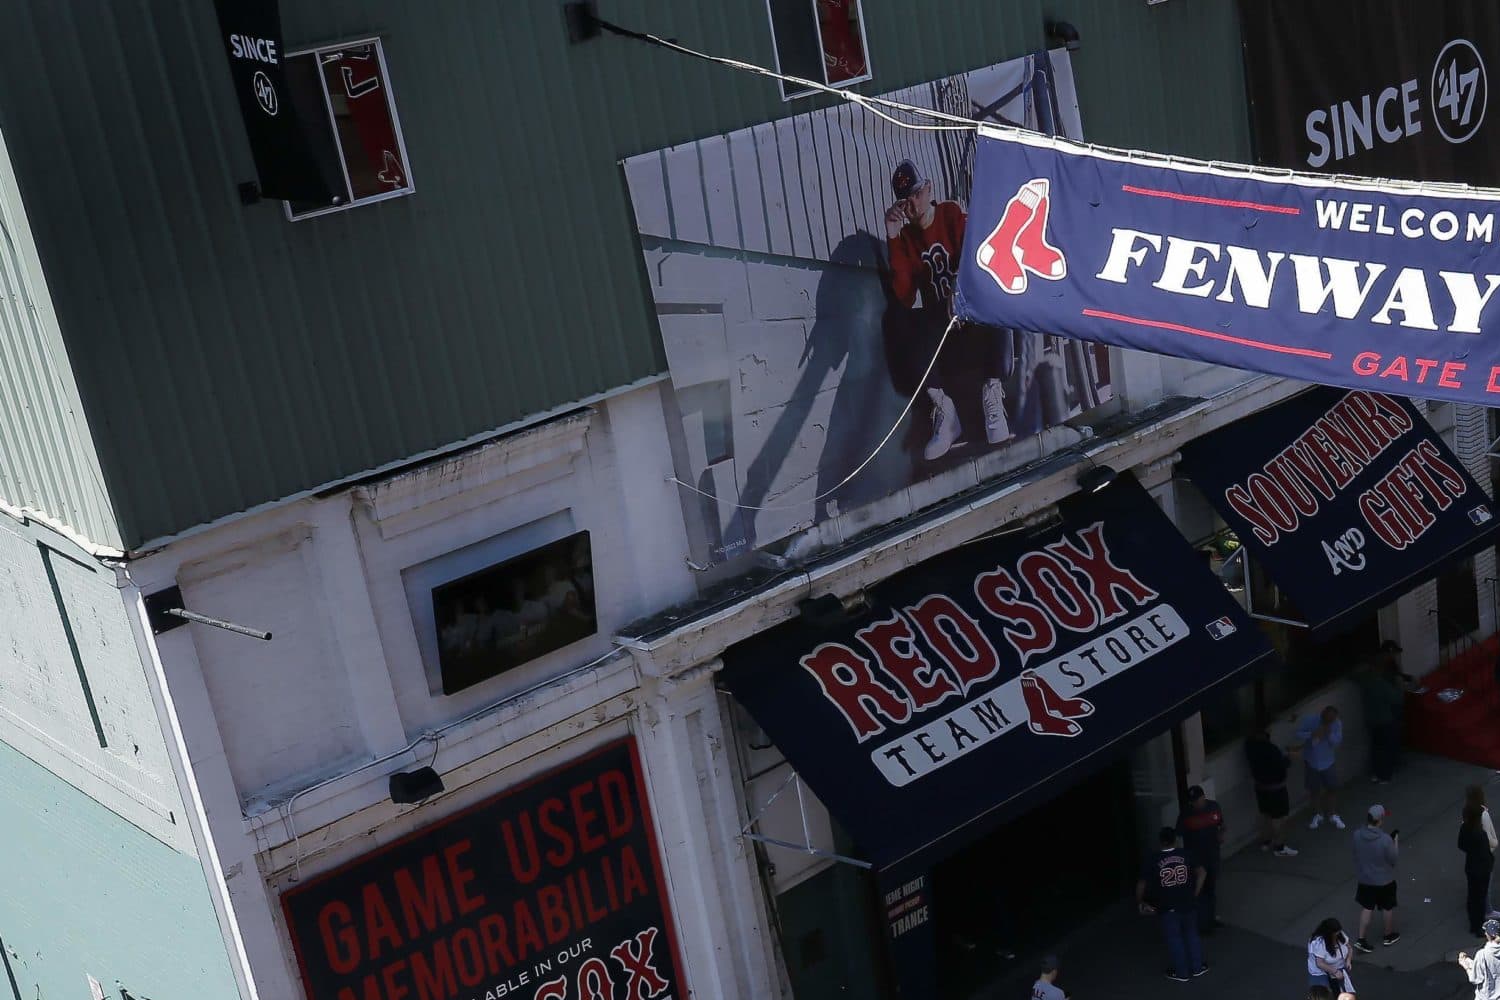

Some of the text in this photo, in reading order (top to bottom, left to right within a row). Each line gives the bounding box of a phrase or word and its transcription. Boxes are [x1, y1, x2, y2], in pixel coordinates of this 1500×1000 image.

[230, 34, 278, 64] SINCE
[1305, 78, 1422, 167] SINCE
[1352, 351, 1466, 389] GATE
[1225, 388, 1412, 547] SOUVENIRS
[1359, 439, 1467, 549] GIFTS
[798, 521, 1160, 744] RED SOX
[884, 612, 1177, 779] TEAM STORE
[319, 769, 635, 975] GAME USED
[1159, 864, 1188, 887] 28
[531, 962, 552, 982] IN
[556, 937, 593, 968] OUR
